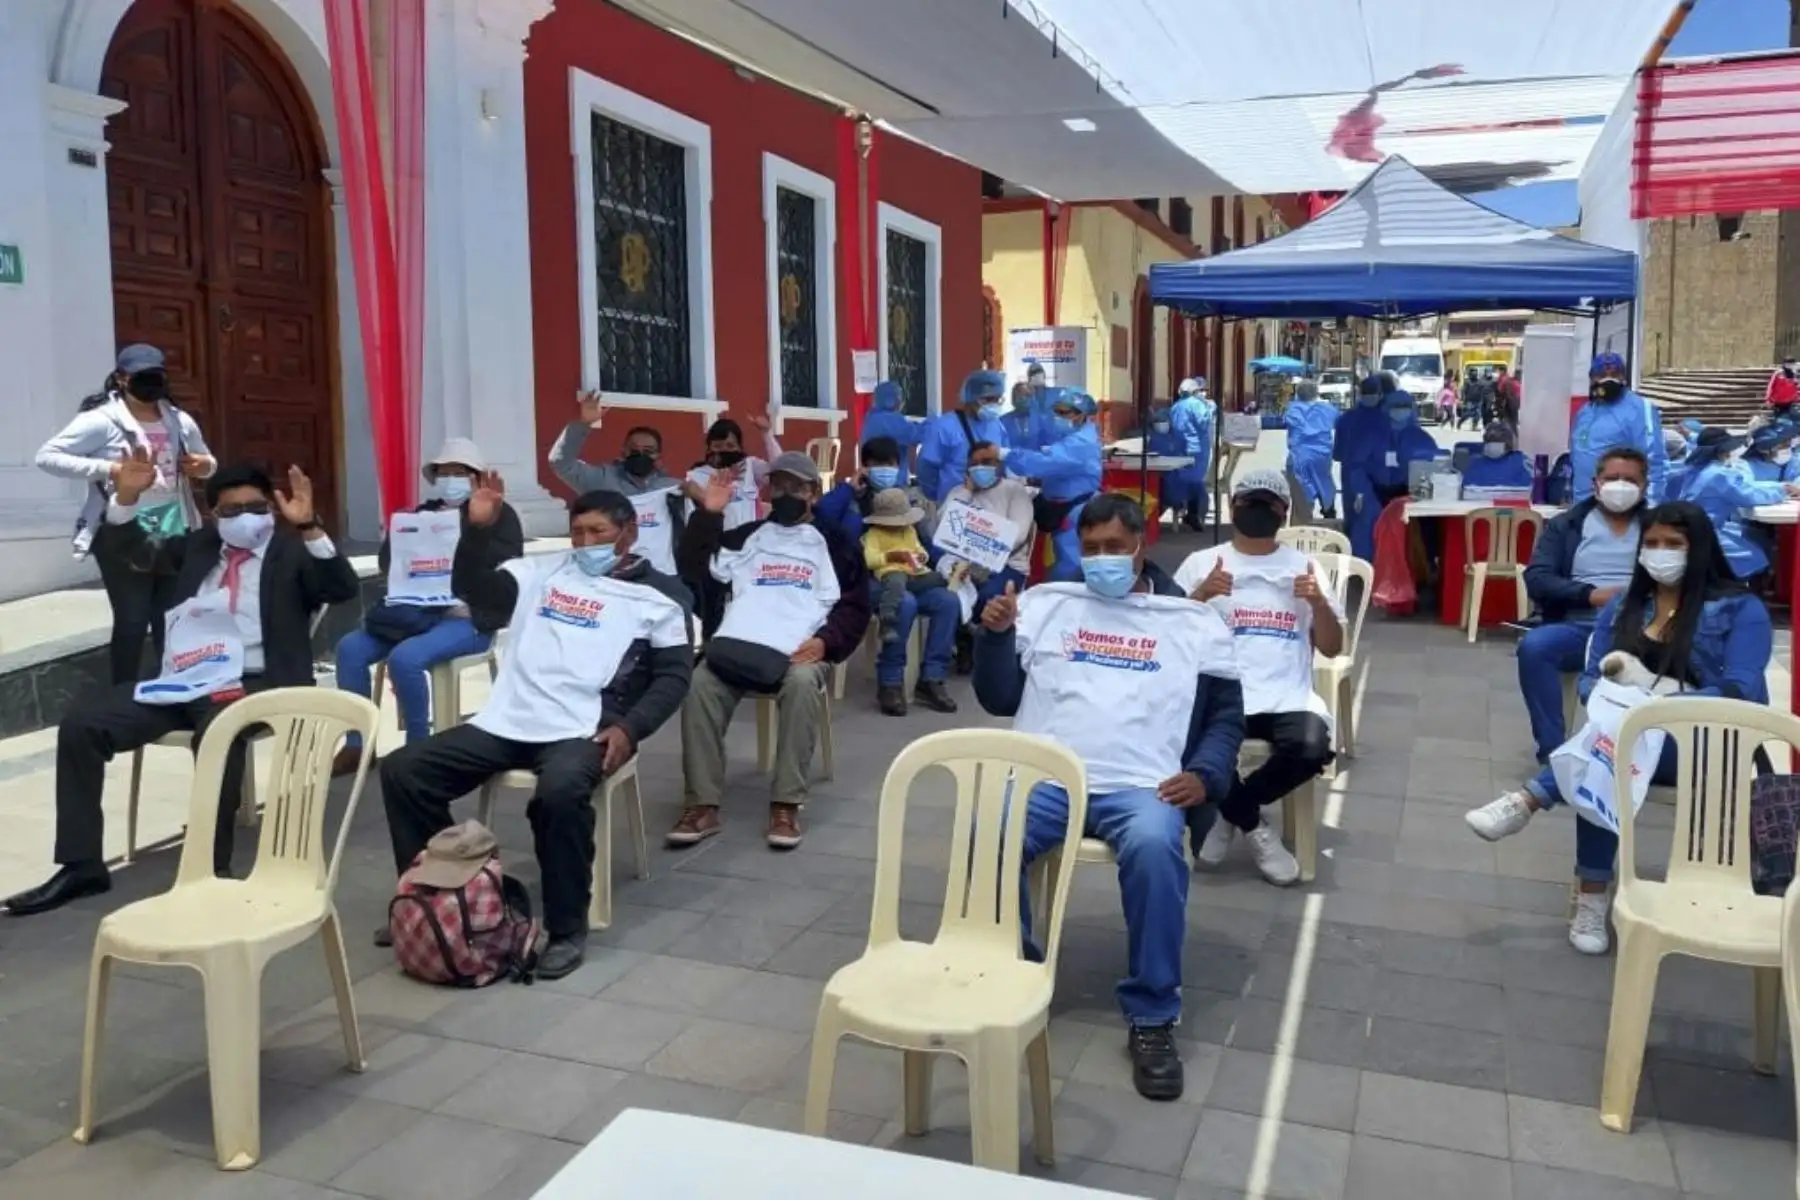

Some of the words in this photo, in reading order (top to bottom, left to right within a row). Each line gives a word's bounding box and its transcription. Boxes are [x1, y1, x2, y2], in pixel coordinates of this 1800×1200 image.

[1234, 608, 1273, 618] Vamos
[1275, 611, 1283, 620] a
[1284, 611, 1297, 622] tu
[1078, 629, 1125, 646] Vamos
[1128, 638, 1138, 647] a
[1140, 638, 1157, 649] tu
[1079, 641, 1153, 660] encuentro
